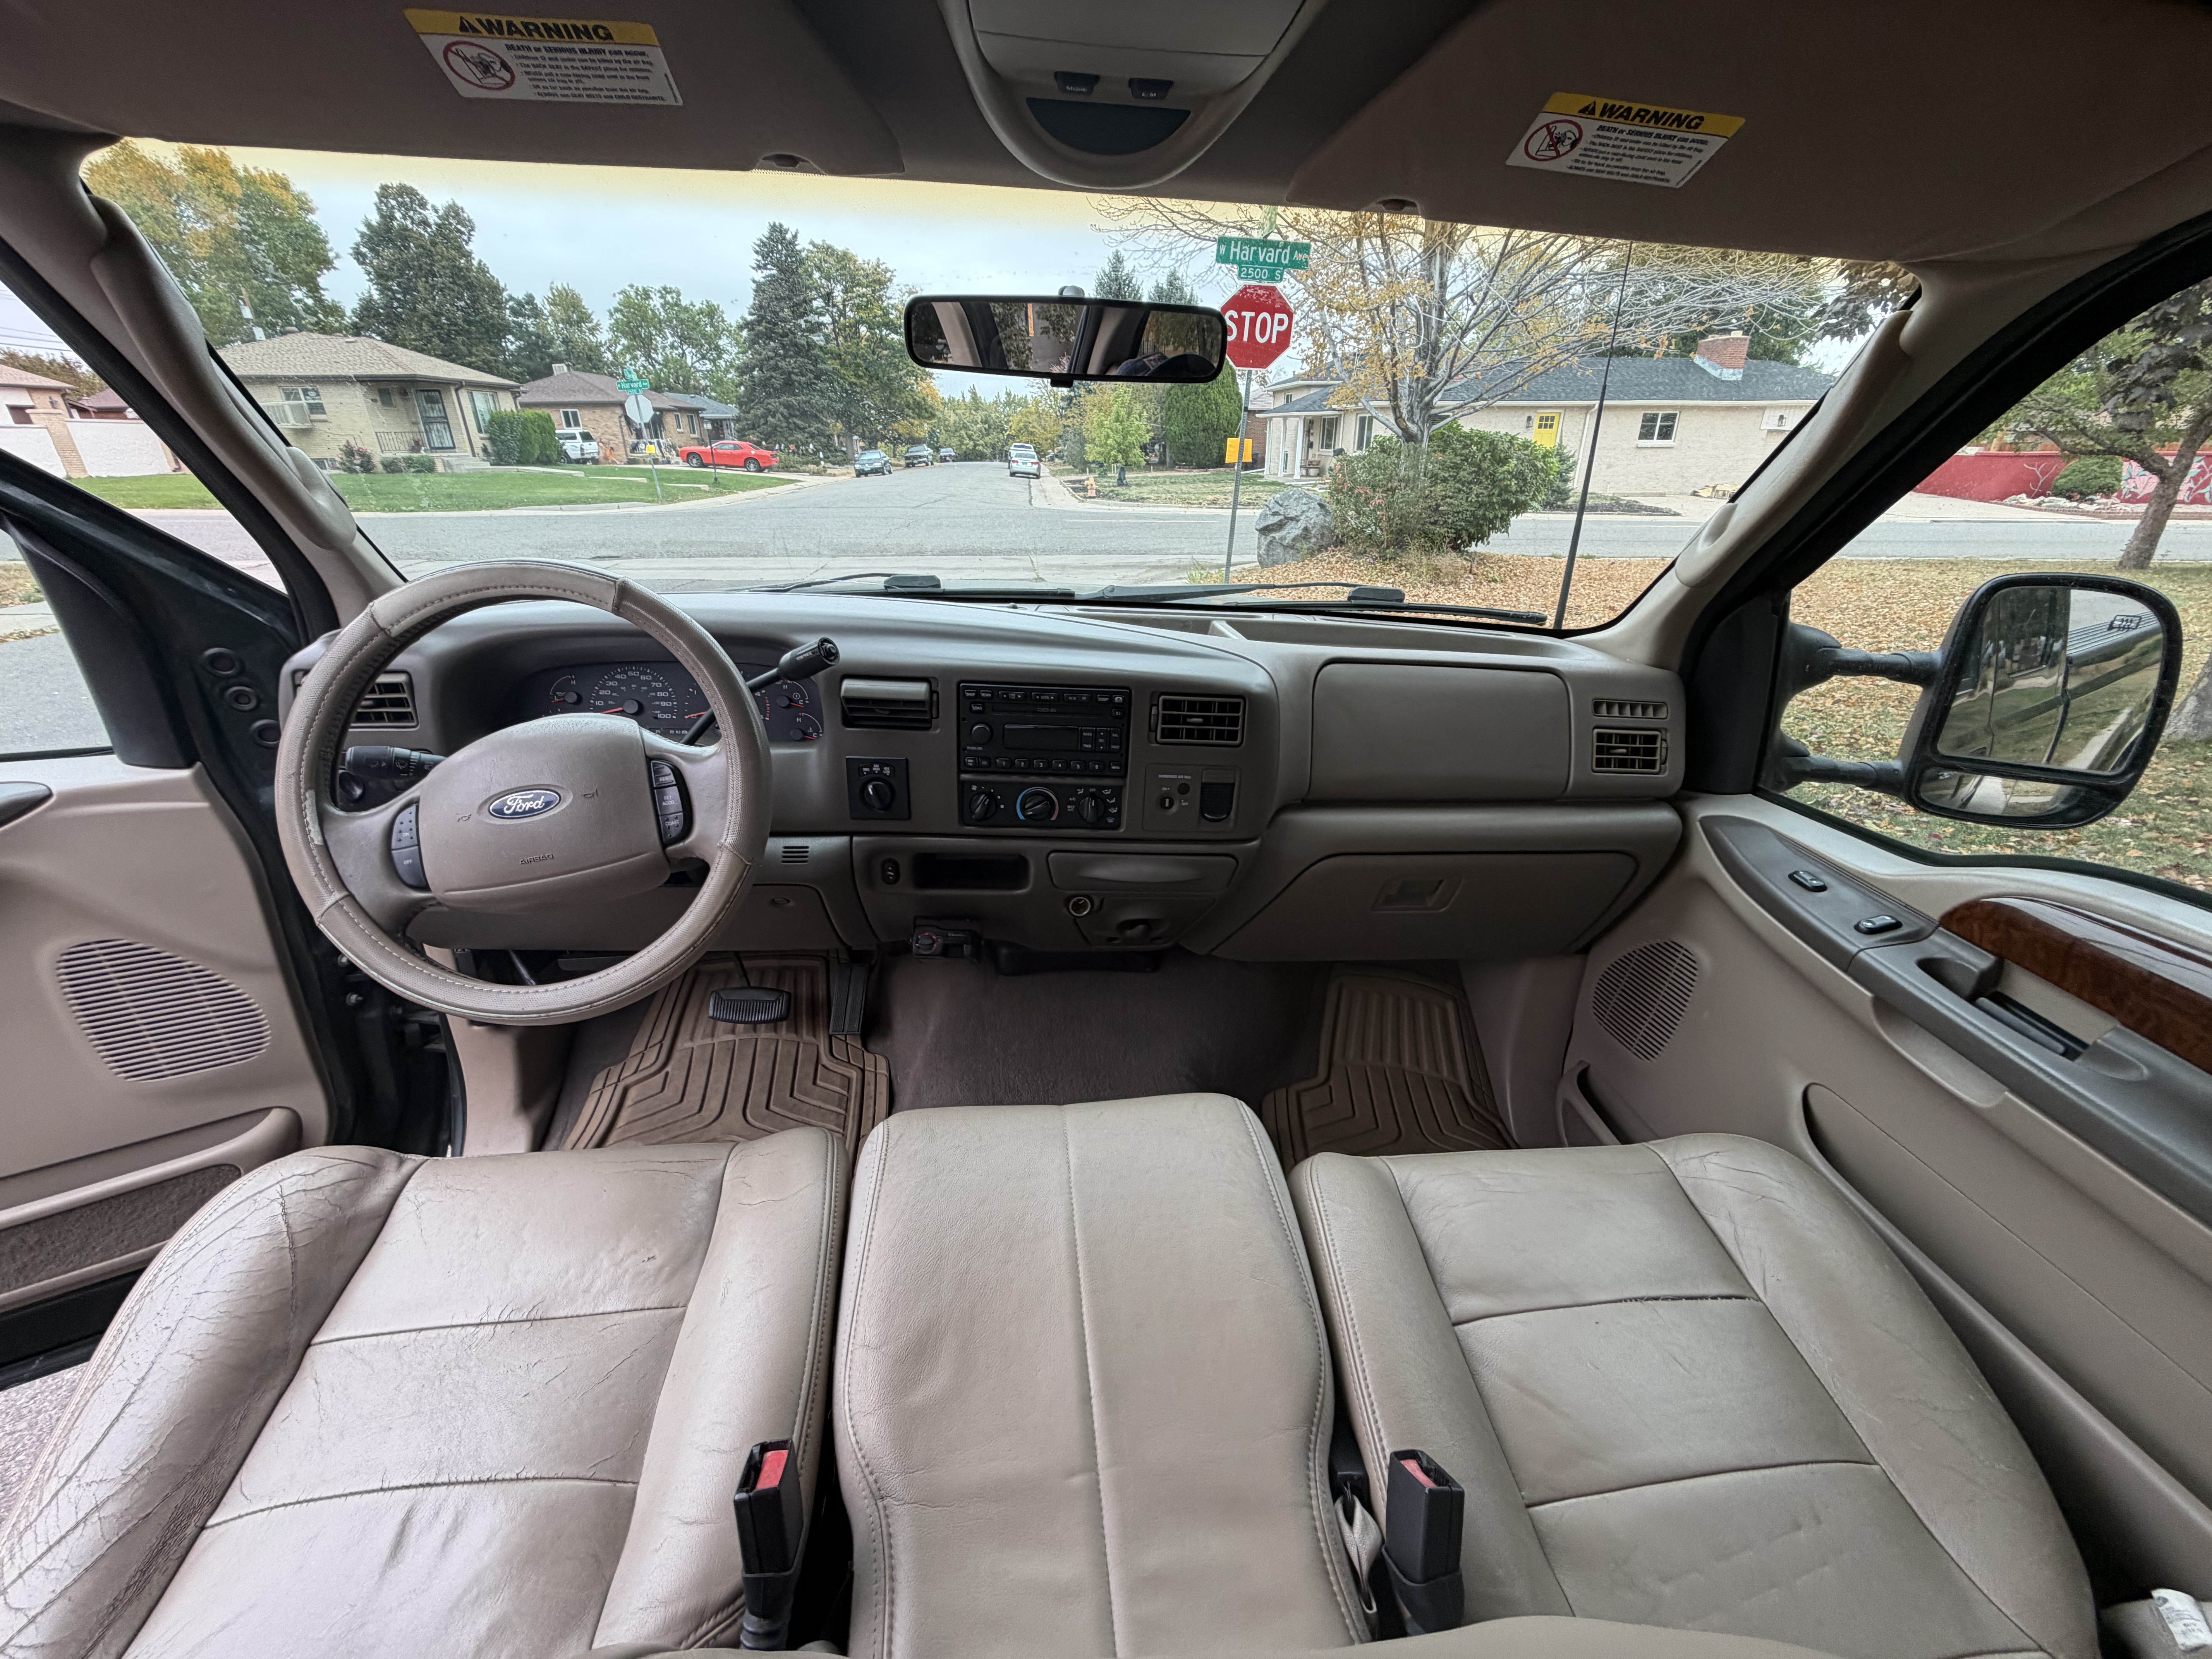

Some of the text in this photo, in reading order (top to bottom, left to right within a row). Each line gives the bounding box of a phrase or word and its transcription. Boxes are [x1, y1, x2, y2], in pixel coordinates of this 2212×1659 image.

[476, 17, 615, 41] WARNING
[1599, 102, 1705, 130] WARNING
[1220, 245, 1226, 254] W
[1230, 241, 1291, 264] Harvard
[1241, 267, 1281, 280] 2500 S
[1225, 310, 1289, 343] STOP
[504, 794, 545, 814] Ford
[520, 854, 554, 865] AIRBAG
